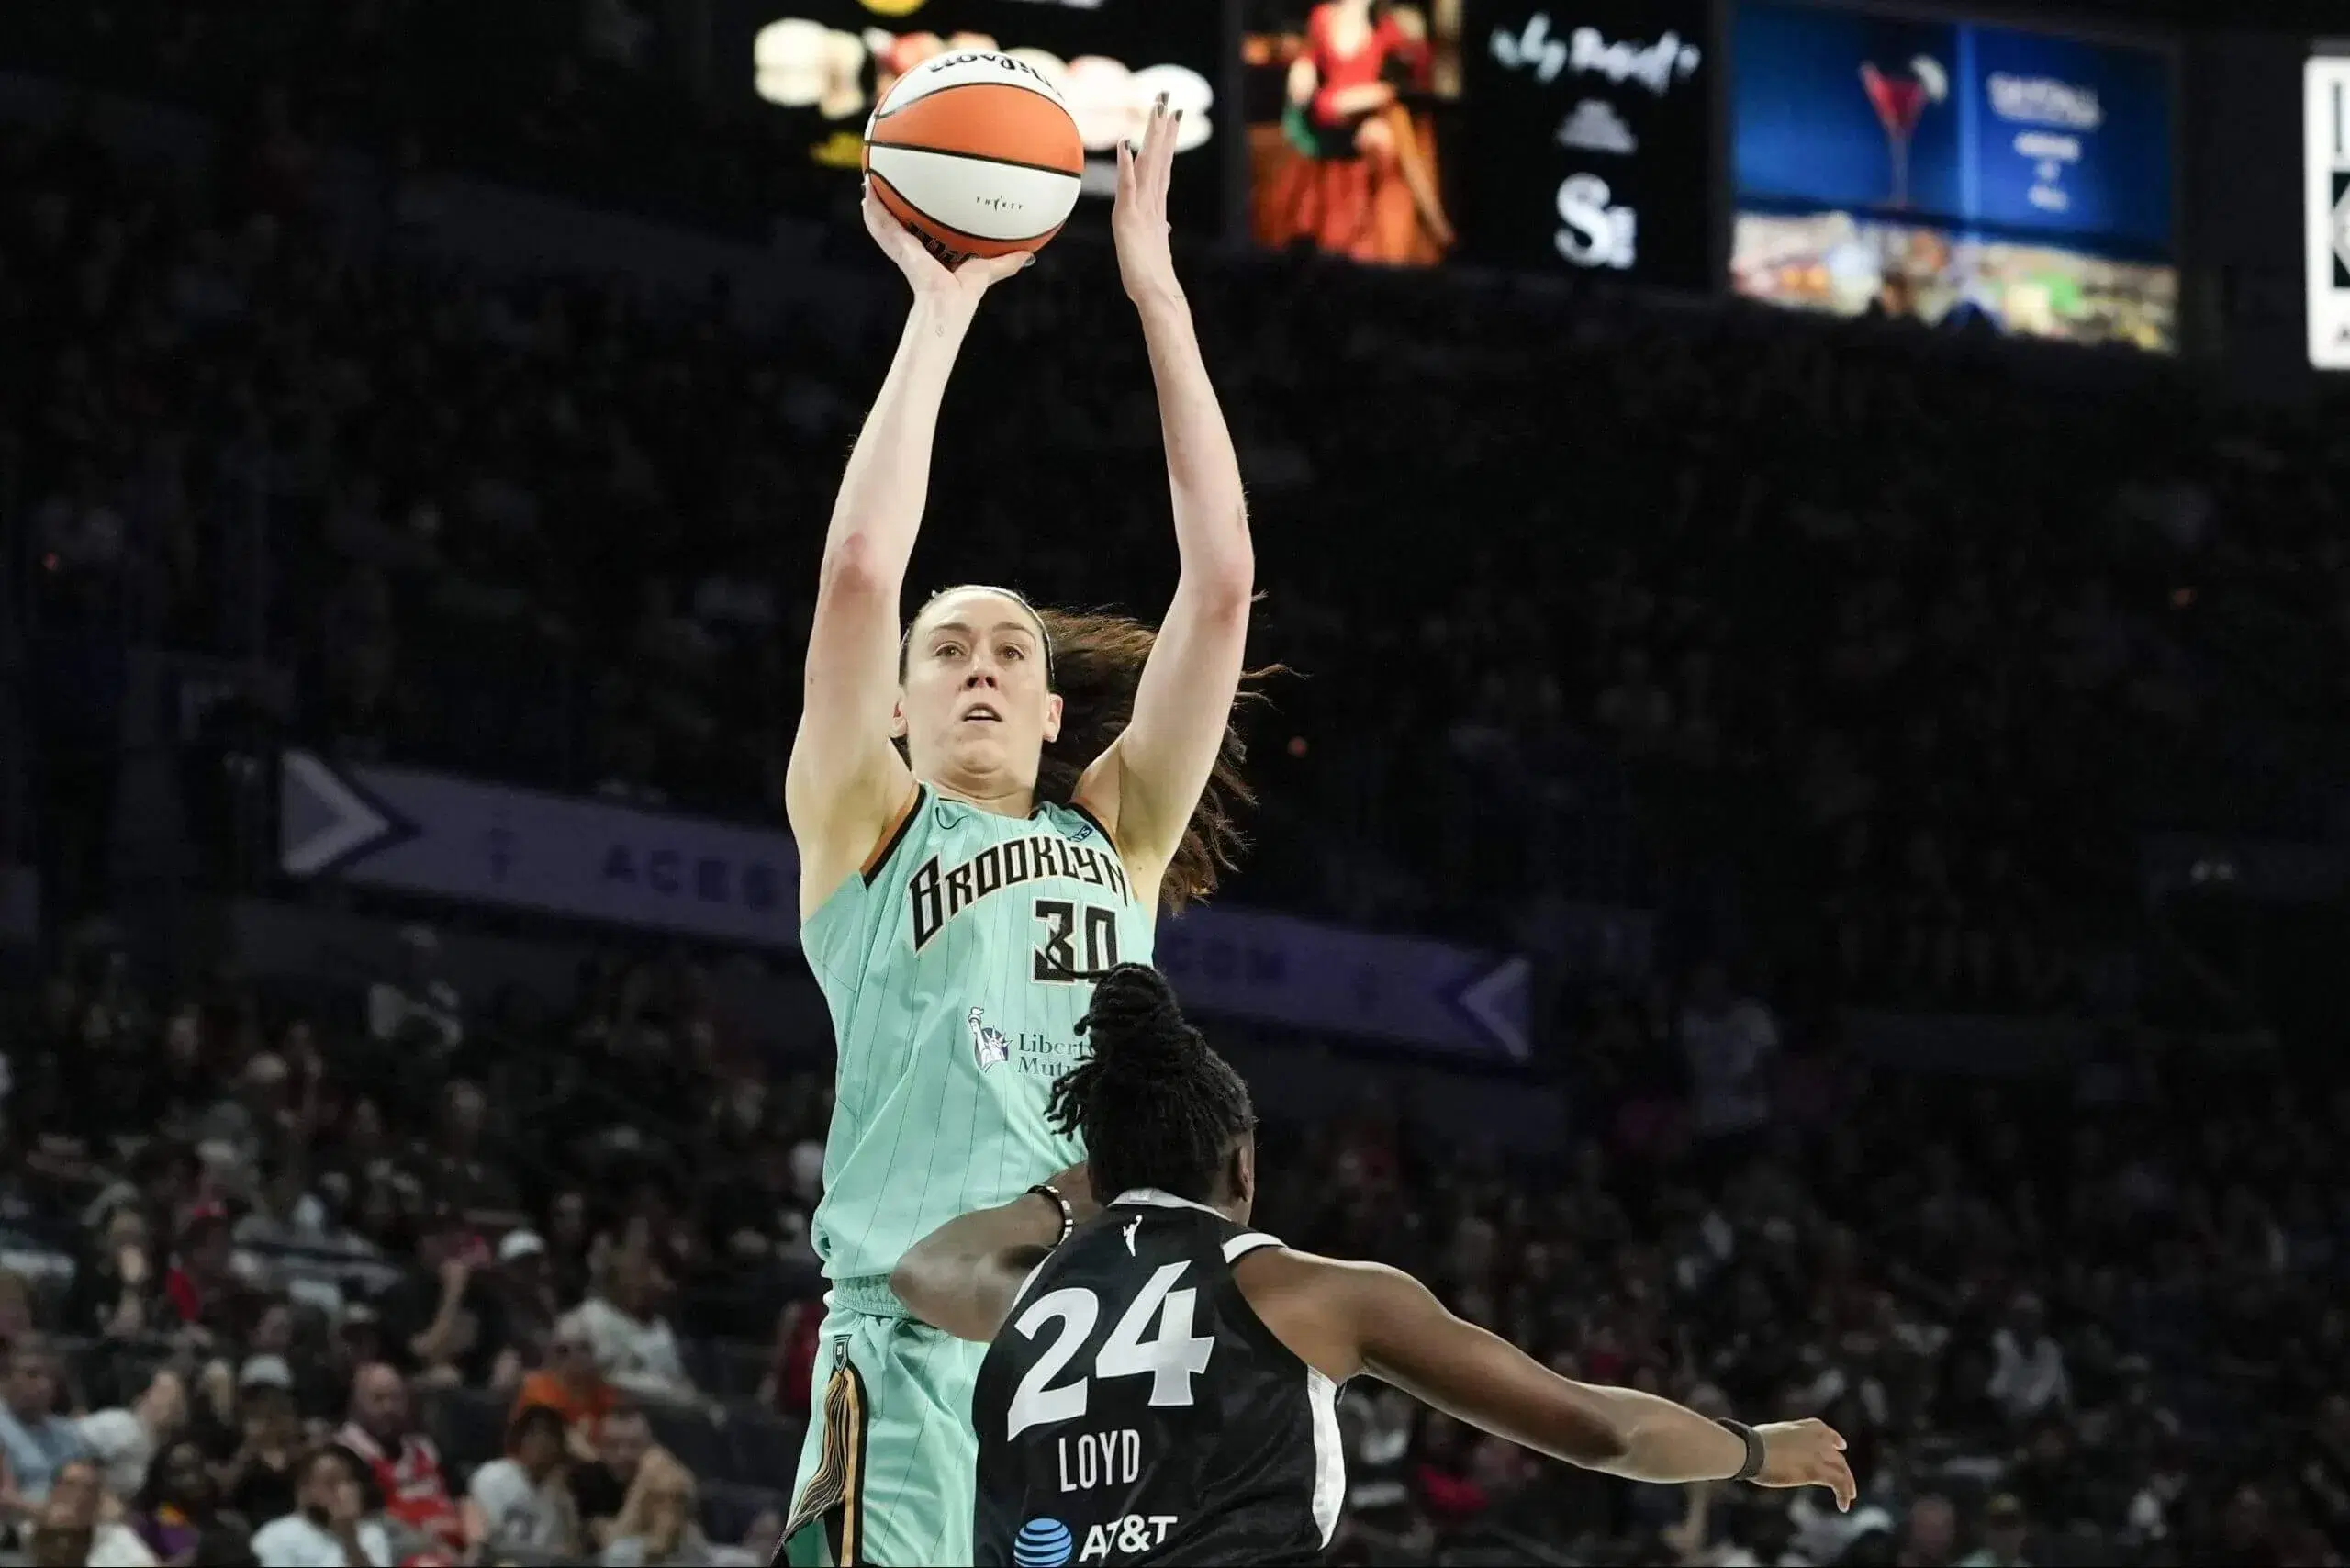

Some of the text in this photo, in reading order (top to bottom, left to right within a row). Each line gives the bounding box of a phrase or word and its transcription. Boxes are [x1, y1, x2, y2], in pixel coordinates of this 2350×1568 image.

[909, 834, 1129, 957] BROOKLYN
[1030, 896, 1119, 986] 30
[1007, 1260, 1215, 1442] 24
[1058, 1428, 1141, 1494] LOYD
[1078, 1513, 1179, 1562] AT&T
